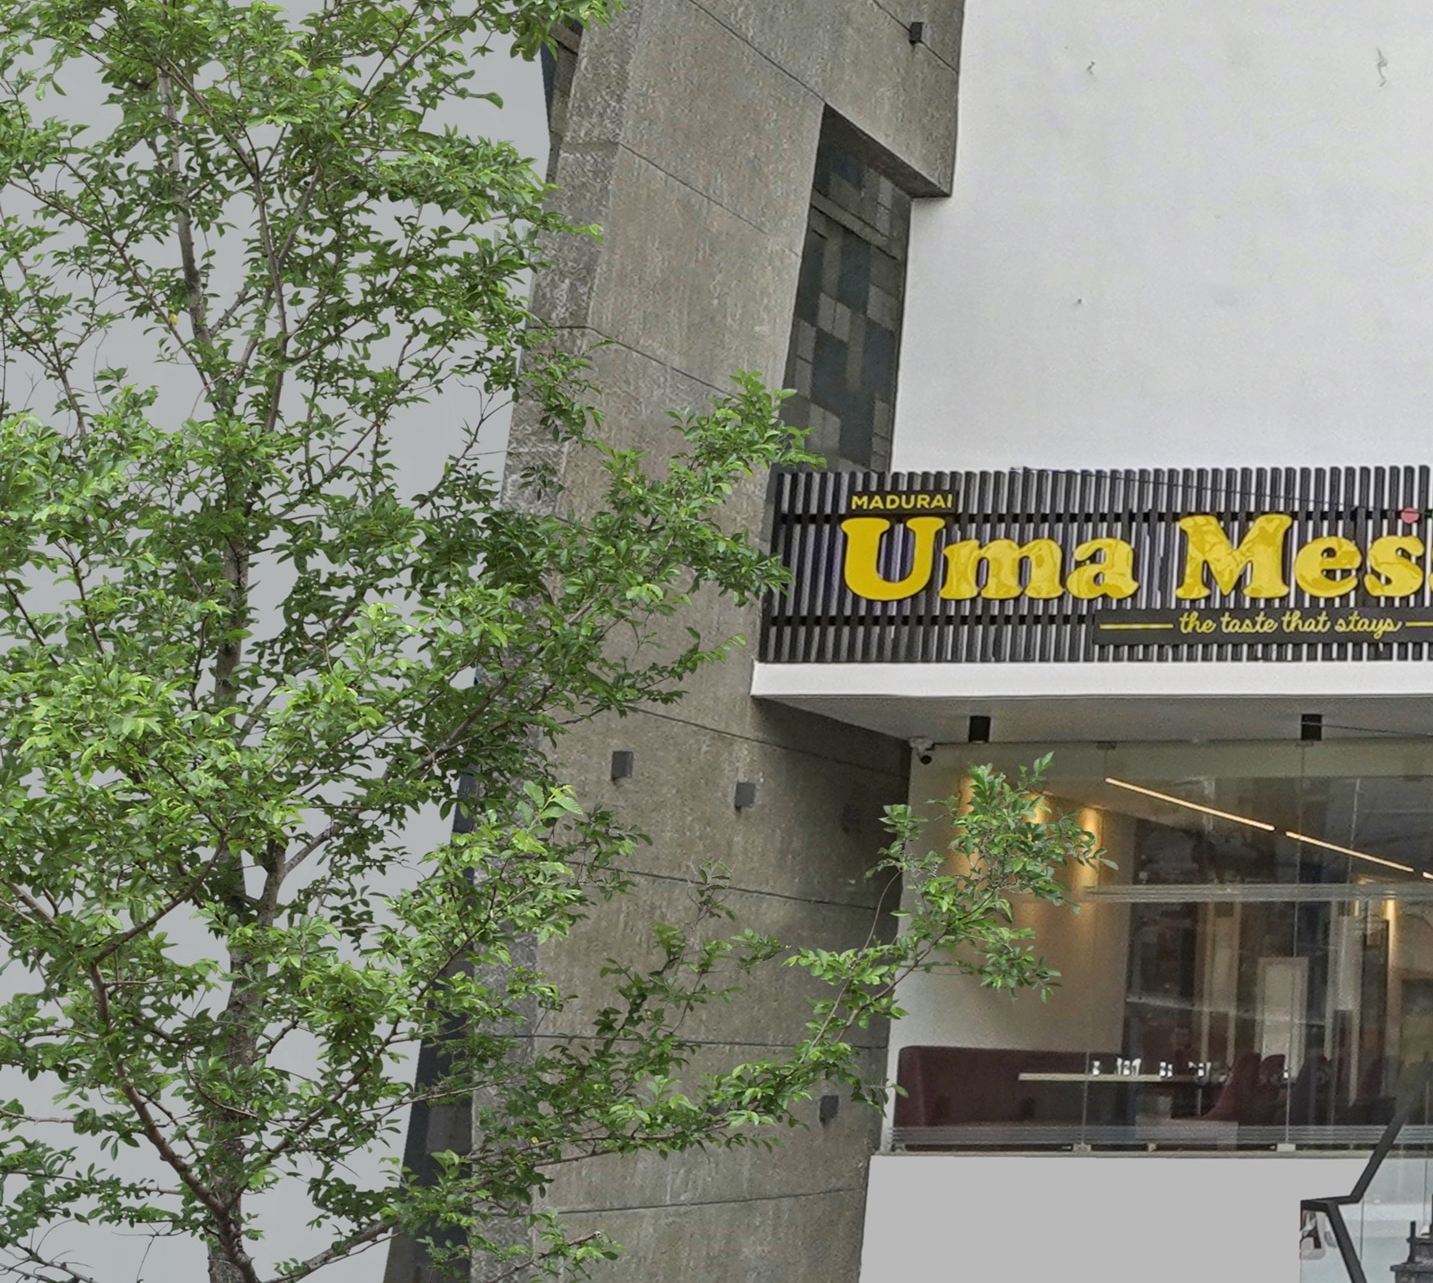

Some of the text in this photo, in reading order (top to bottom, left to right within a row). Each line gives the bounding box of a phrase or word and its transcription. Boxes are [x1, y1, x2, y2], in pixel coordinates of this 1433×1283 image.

[850, 493, 953, 512] MADURAI
[841, 517, 1139, 601] Uma
[1178, 612, 1403, 642] the taste that stays
